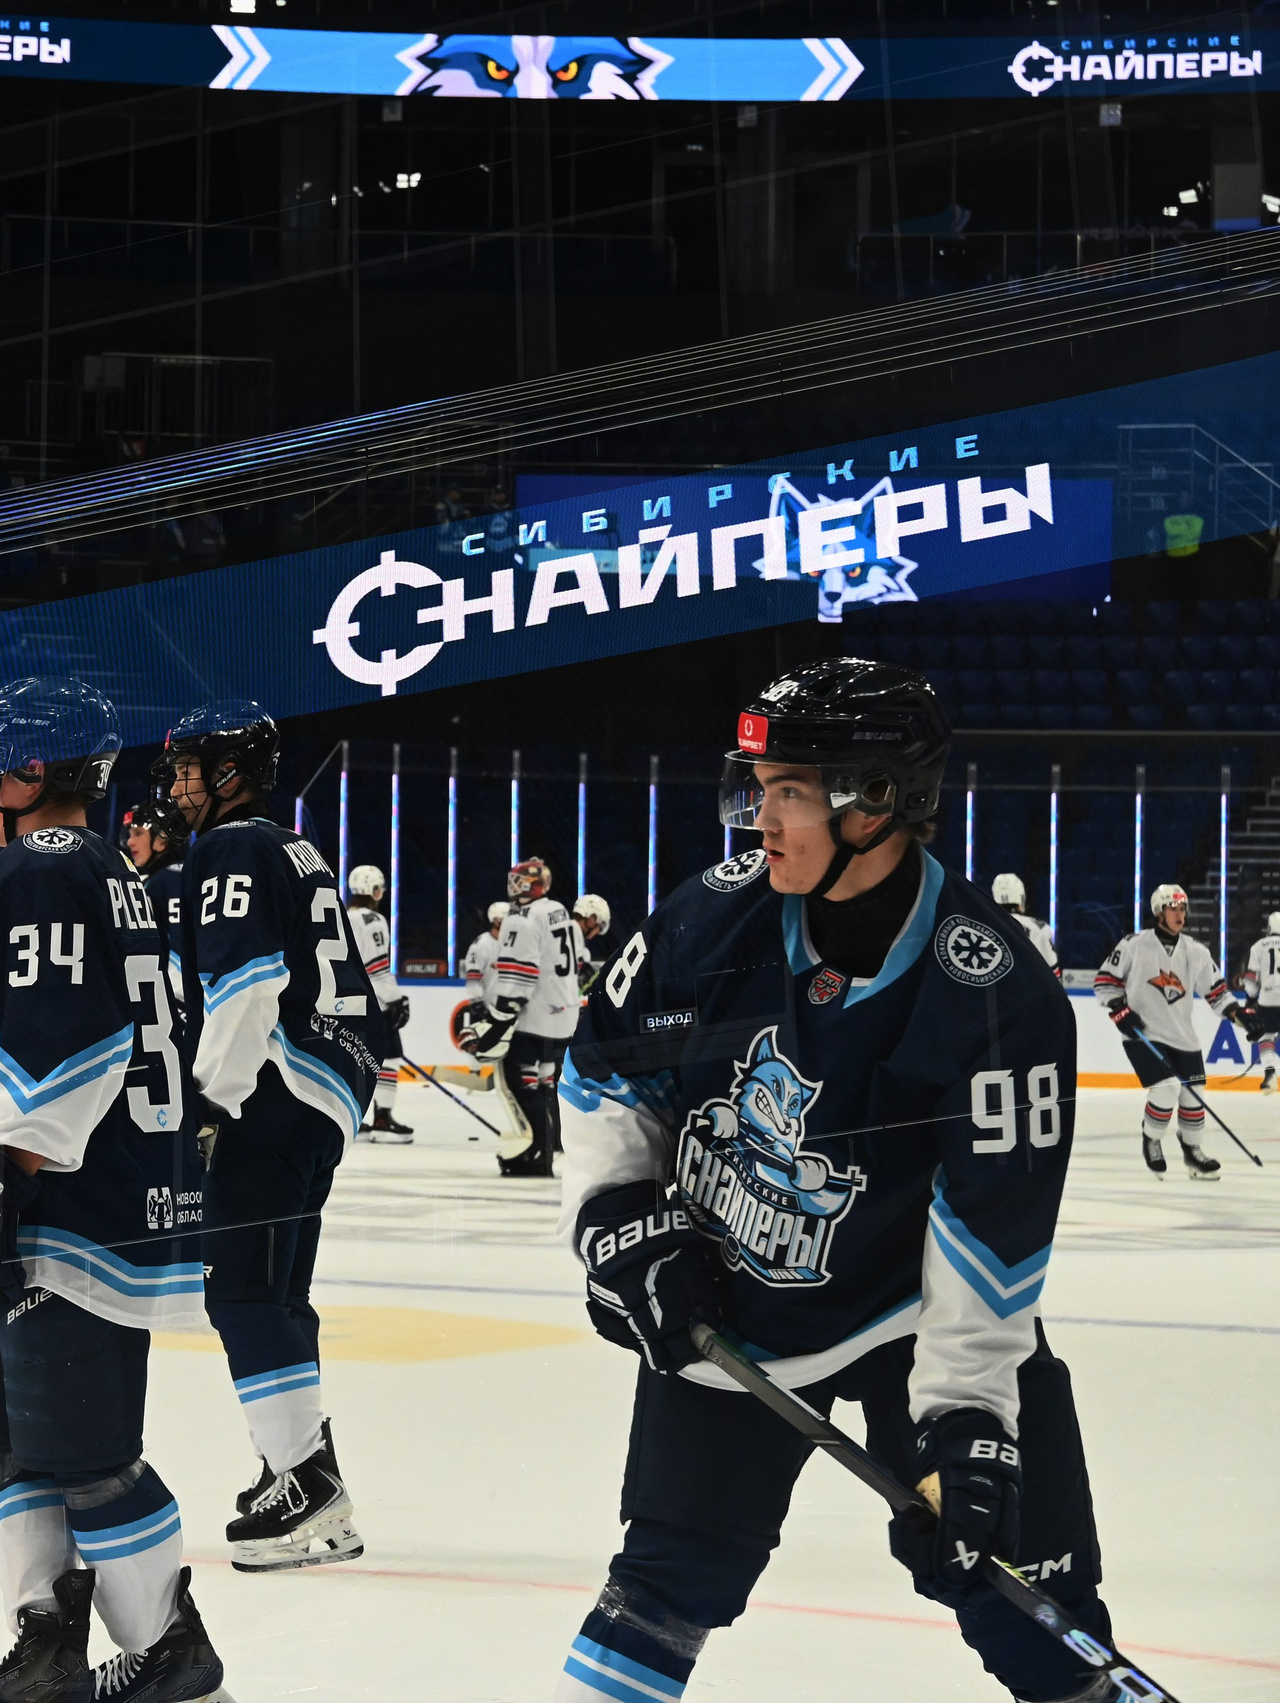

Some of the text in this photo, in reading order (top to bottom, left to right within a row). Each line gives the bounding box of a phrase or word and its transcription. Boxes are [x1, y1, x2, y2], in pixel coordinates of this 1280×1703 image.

[1007, 40, 1263, 97] СНАЙПЕРЫ
[1061, 35, 1240, 50] СИБИРСКИЕ
[461, 433, 979, 558] СИБИРСКИЕ
[312, 462, 1053, 696] СНАЙПЕРЫ
[106, 877, 158, 930] PLEZ
[168, 897, 181, 924] 5
[200, 873, 253, 926] 26
[8, 923, 86, 988] 34
[1268, 948, 1280, 975] 1
[646, 1012, 694, 1029] ВЫХОД
[970, 1061, 1061, 1154] 98
[724, 1147, 789, 1207] СИБИРСКИЕ
